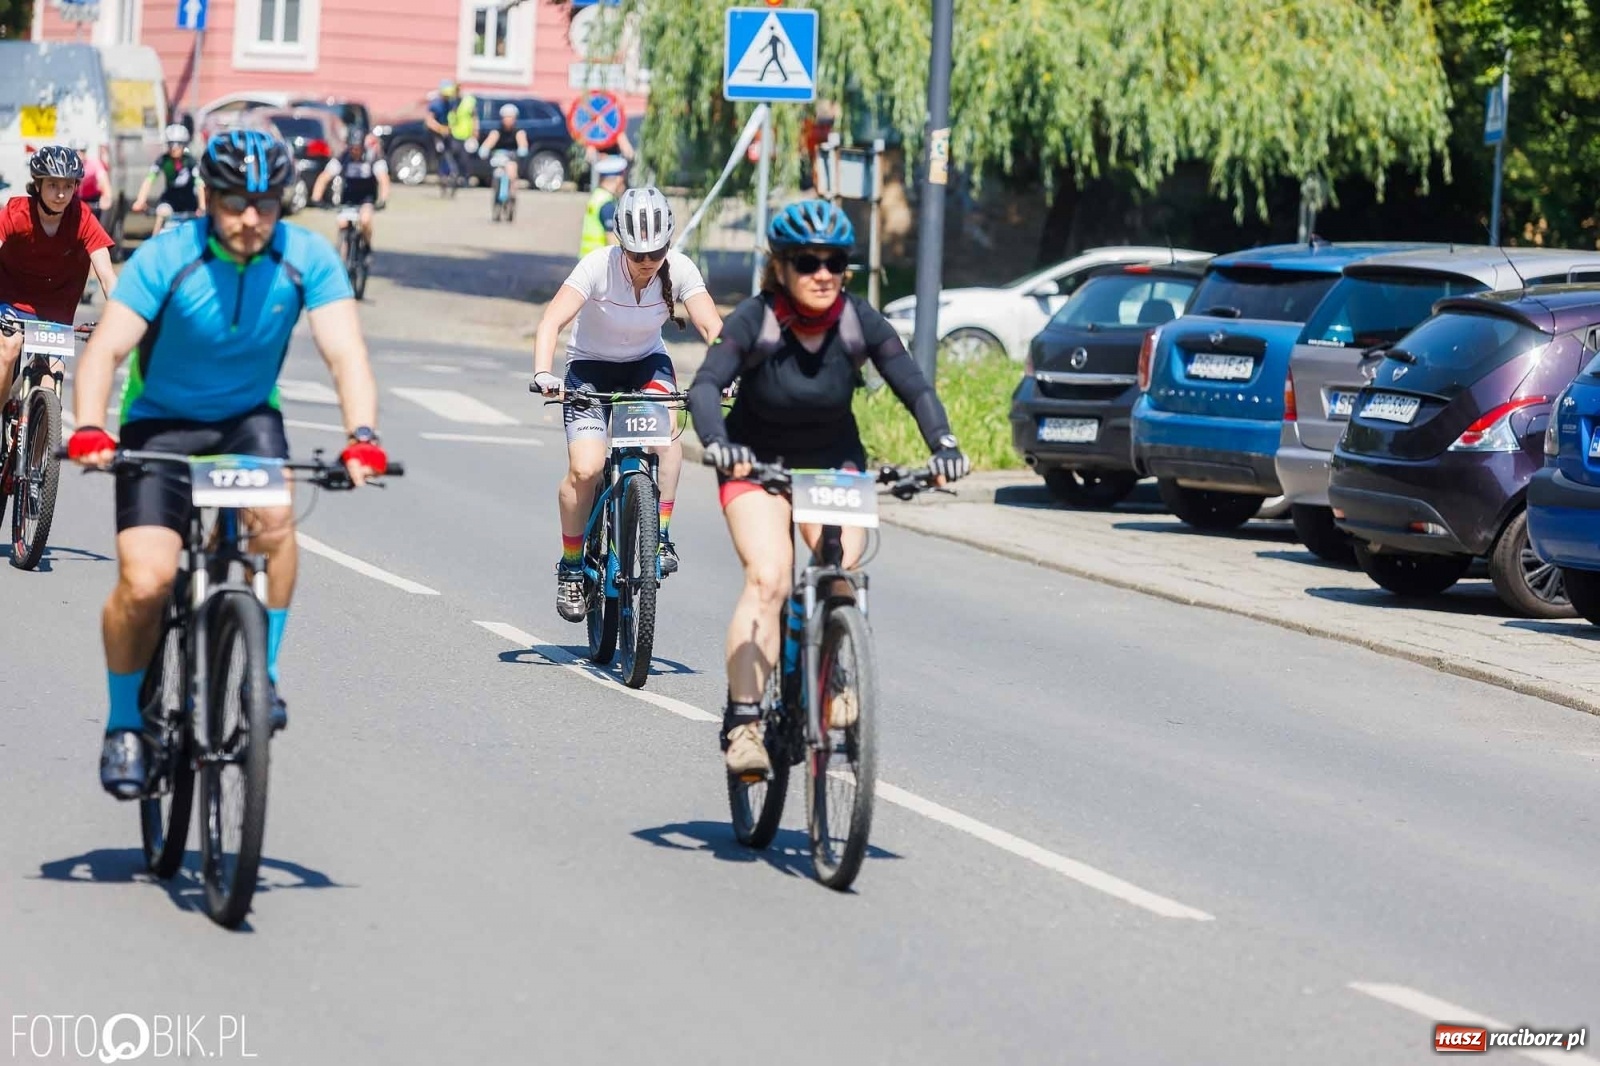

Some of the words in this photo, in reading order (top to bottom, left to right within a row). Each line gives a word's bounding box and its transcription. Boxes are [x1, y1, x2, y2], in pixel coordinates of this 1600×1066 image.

[34, 331, 66, 344] 1995
[625, 417, 657, 432] 1132
[808, 486, 862, 508] 1966
